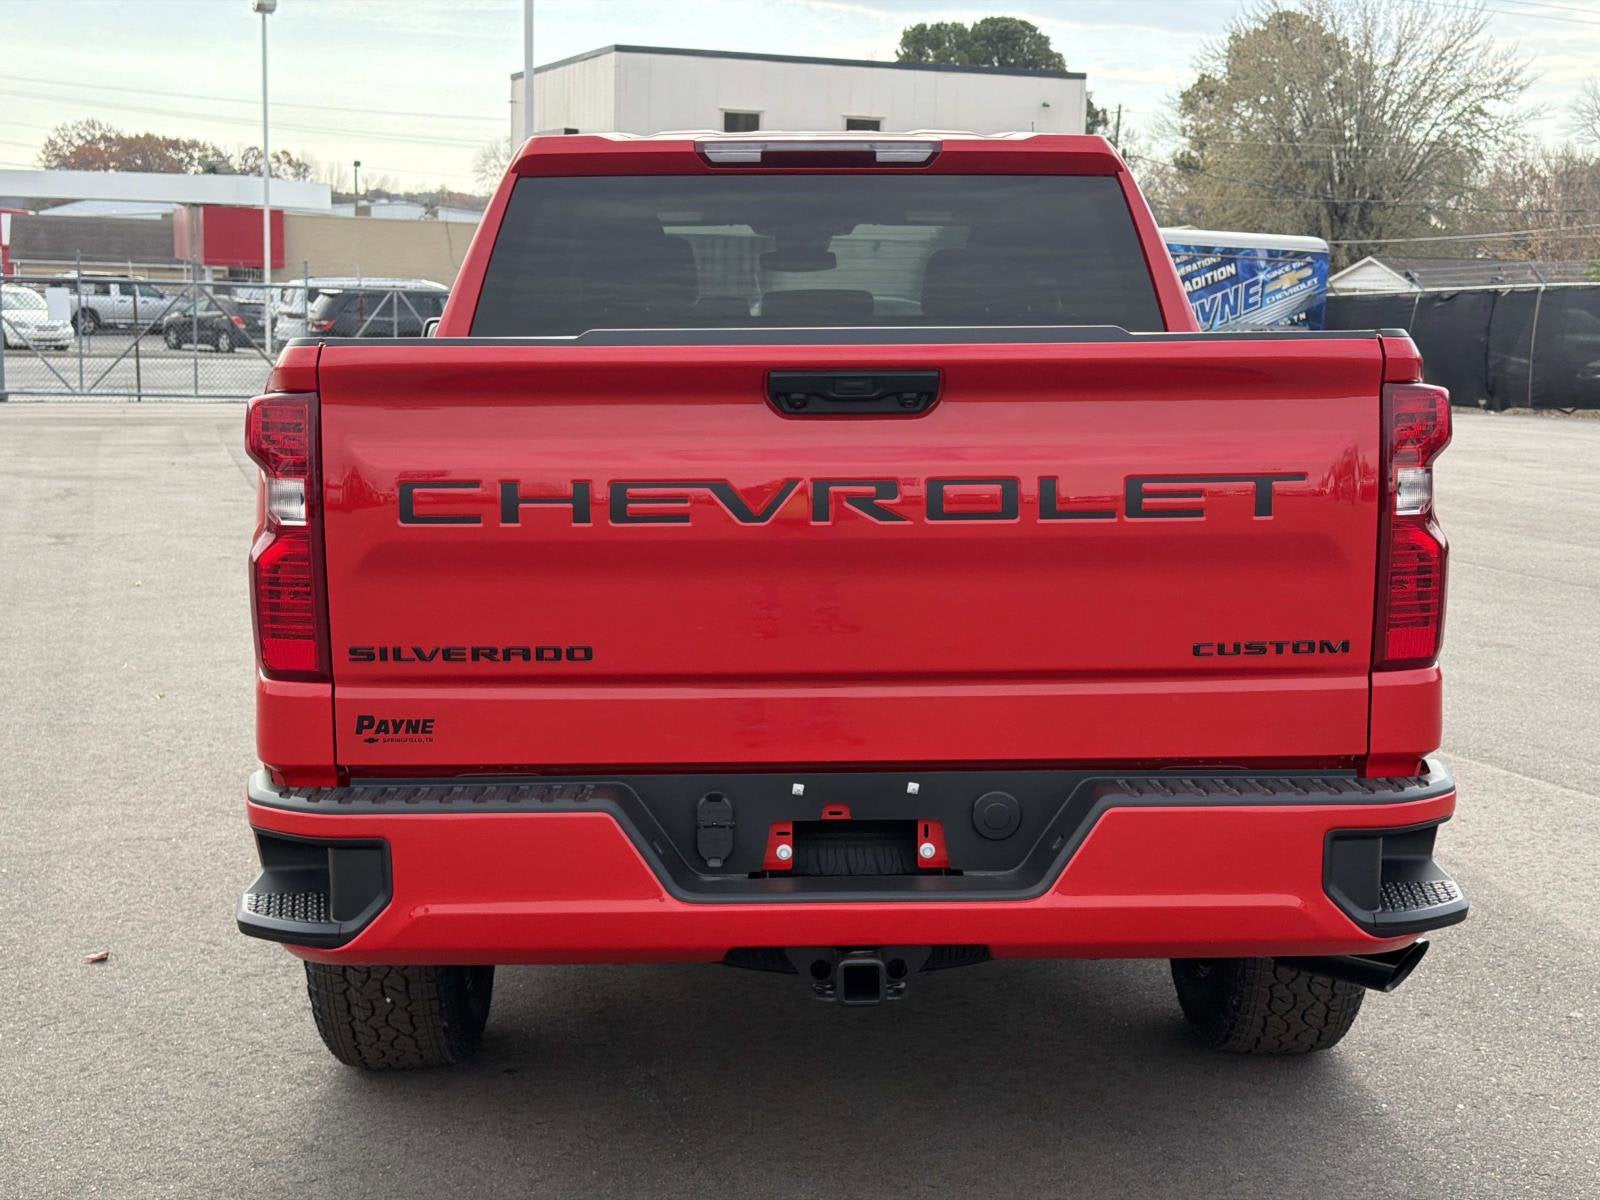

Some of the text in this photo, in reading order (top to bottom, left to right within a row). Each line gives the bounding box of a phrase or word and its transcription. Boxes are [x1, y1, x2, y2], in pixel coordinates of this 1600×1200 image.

[1184, 262, 1237, 293] ADITION
[1265, 277, 1319, 304] CHEVROLET
[1191, 274, 1264, 331] YNE
[398, 471, 1308, 526] CHEVROLET
[348, 645, 593, 662] SILVERADO
[1192, 639, 1350, 657] CUSTOM
[355, 714, 436, 735] PAYNE
